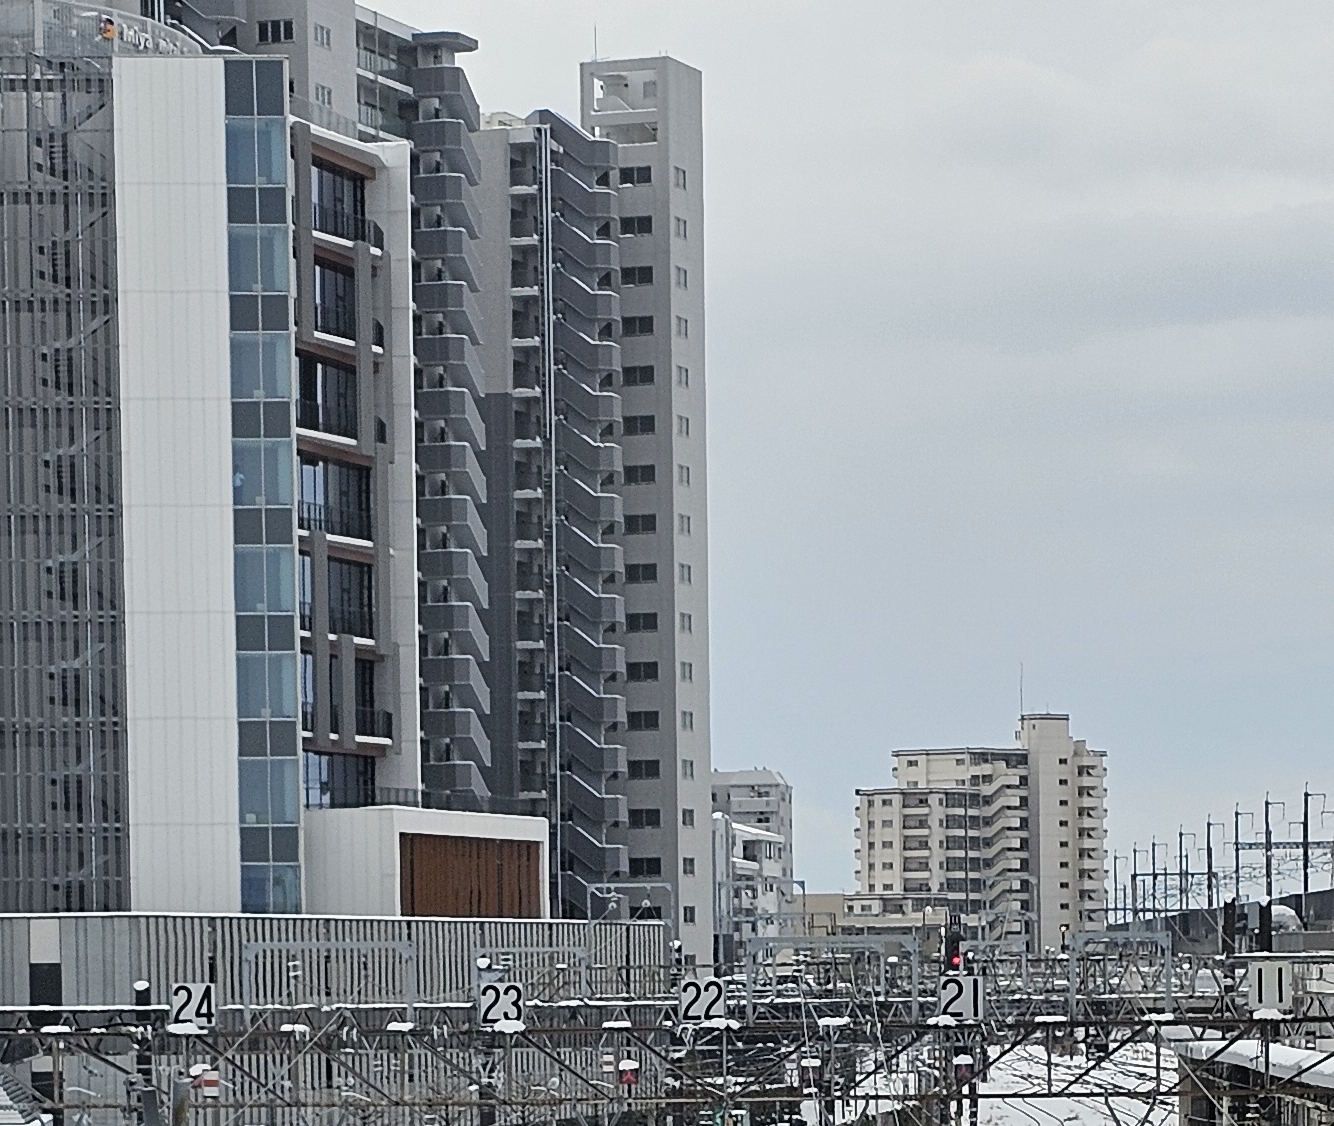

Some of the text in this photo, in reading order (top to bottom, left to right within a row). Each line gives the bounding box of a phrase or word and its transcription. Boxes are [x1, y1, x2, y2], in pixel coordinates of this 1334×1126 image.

[172, 985, 215, 1025] 24
[481, 983, 523, 1024] 23
[681, 981, 724, 1021] 22
[941, 977, 980, 1018] 21
[1257, 967, 1285, 1004] 11
